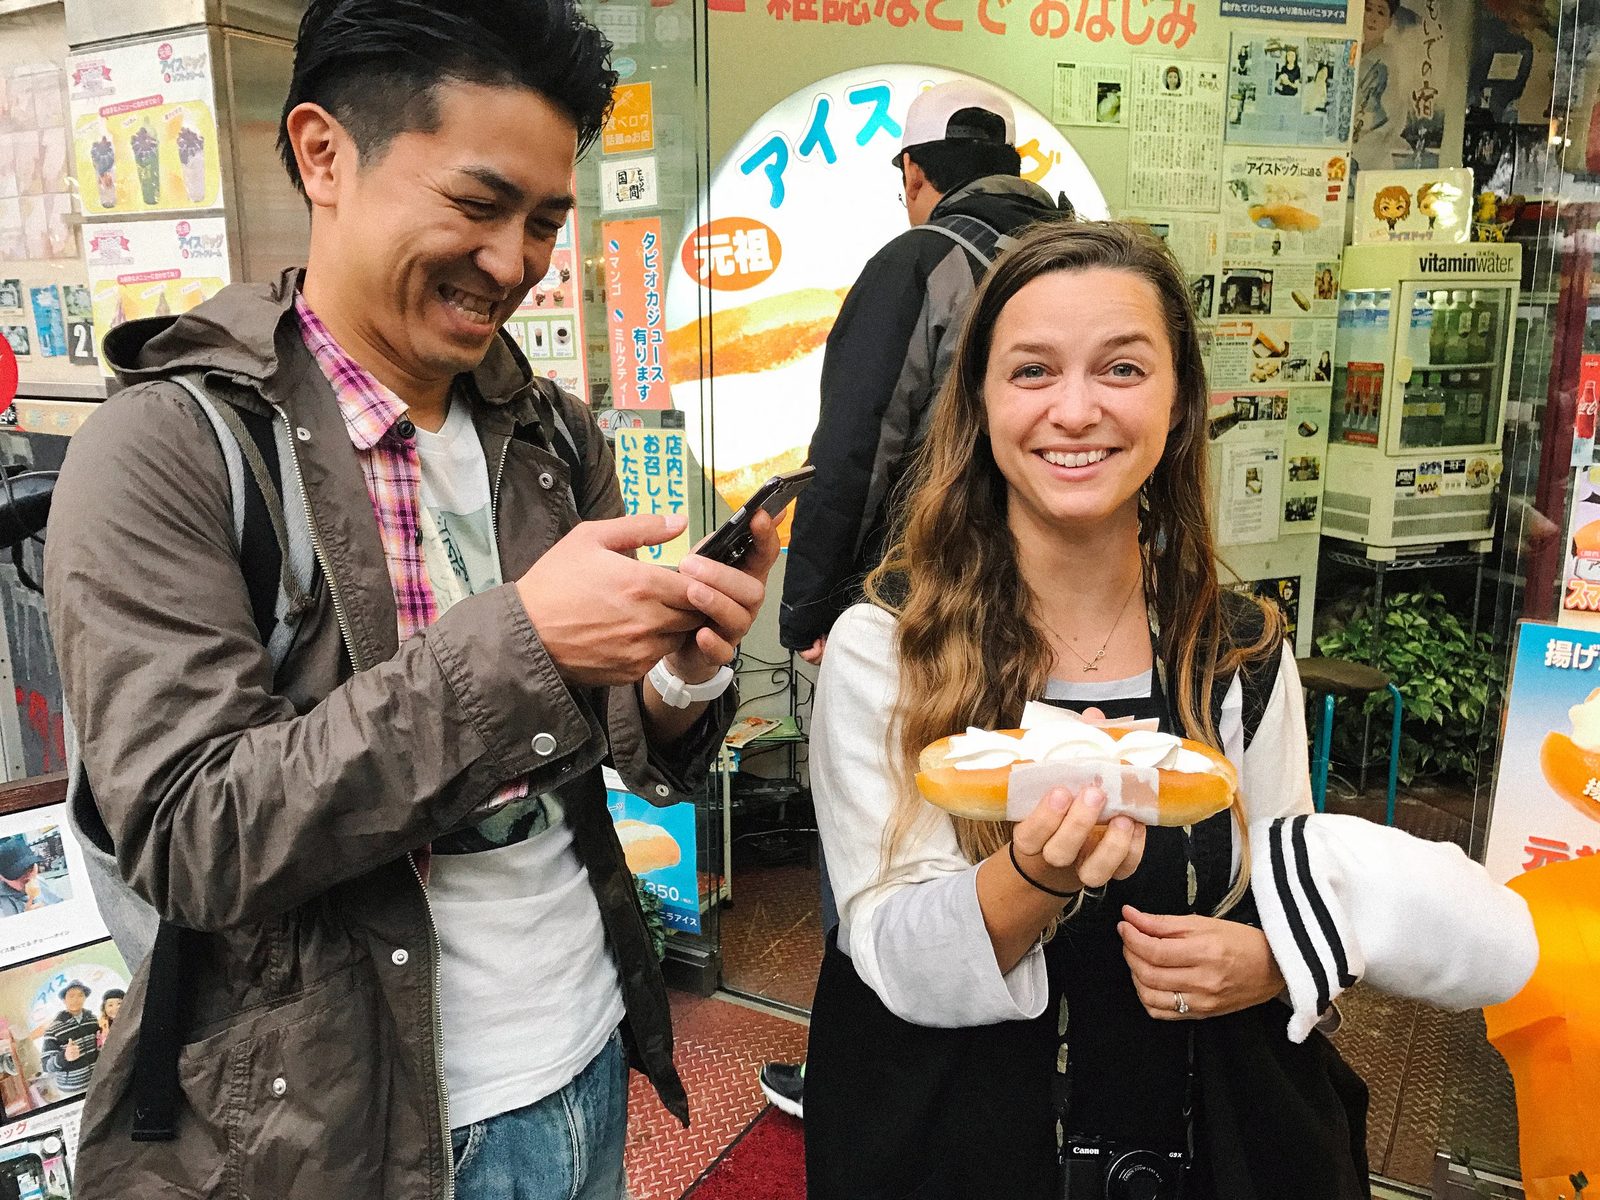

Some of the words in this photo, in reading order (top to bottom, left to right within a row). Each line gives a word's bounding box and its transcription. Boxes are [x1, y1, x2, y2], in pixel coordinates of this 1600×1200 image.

[693, 228, 773, 278] 元祖
[643, 232, 664, 382] タピオカジュース
[614, 328, 627, 407] ミルクティー
[633, 328, 649, 401] 有ります
[1073, 1147, 1099, 1155] Canon
